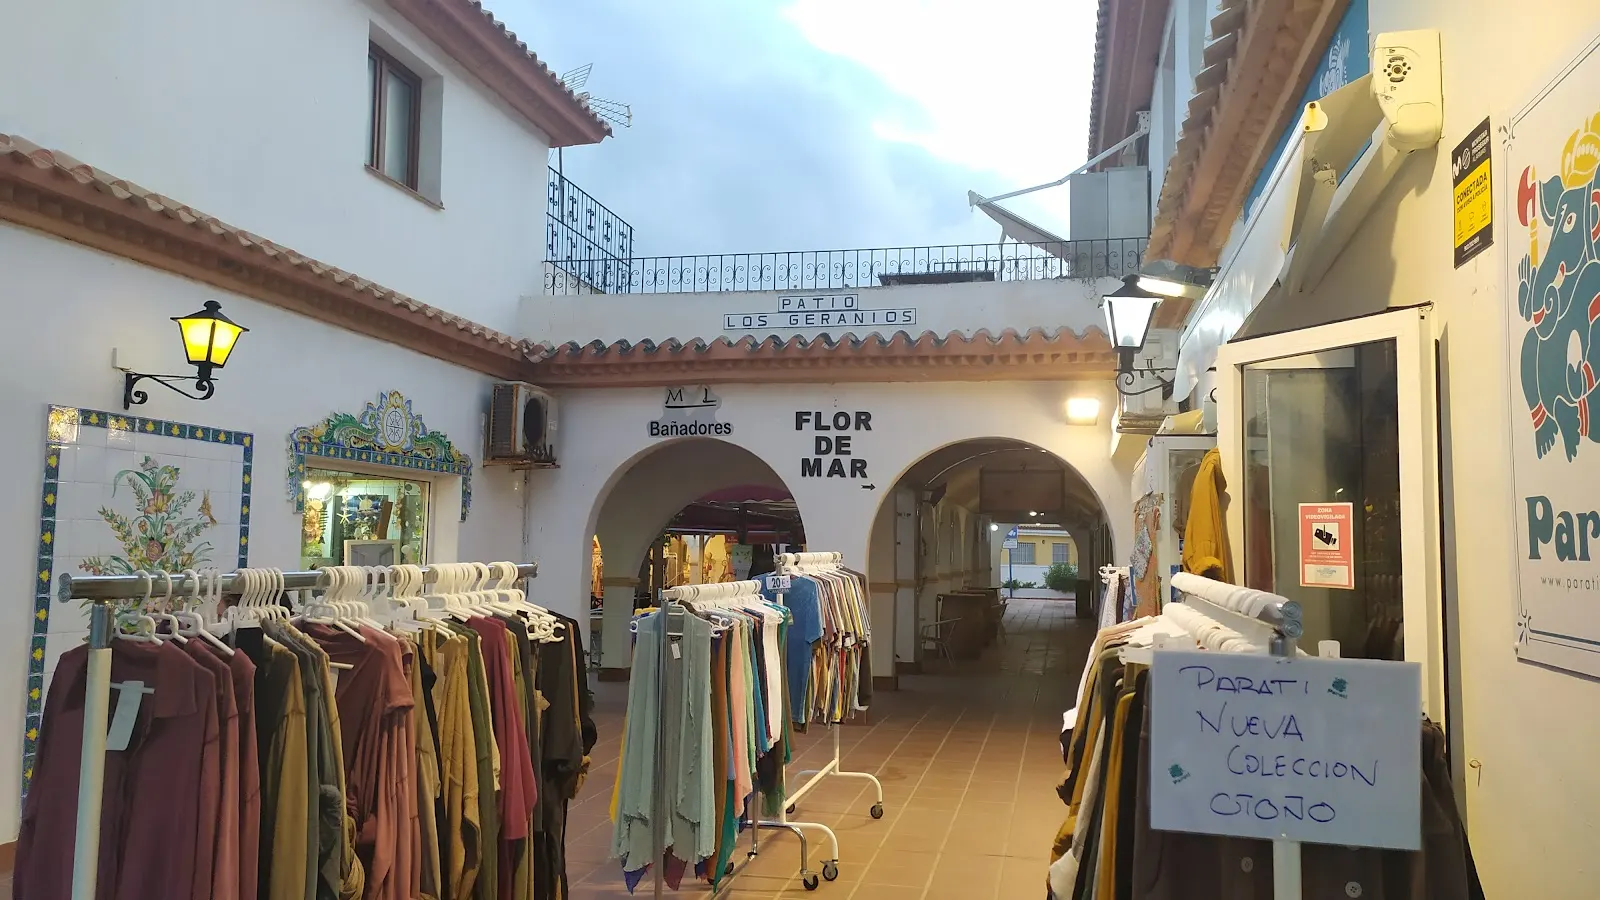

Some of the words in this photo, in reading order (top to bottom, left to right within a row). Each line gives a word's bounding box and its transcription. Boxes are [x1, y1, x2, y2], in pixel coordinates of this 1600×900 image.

[1456, 171, 1488, 205] CONECTADA
[782, 296, 855, 310] PATIO
[727, 315, 768, 328] LOS
[789, 311, 912, 326] GERANIOS
[650, 420, 732, 437] Bañadores
[795, 411, 873, 431] FLOR
[814, 435, 852, 456] DE
[801, 458, 868, 479] MAR
[1178, 665, 1309, 694] PARATI
[1196, 701, 1304, 742] NUEVA
[1226, 745, 1379, 787] COLECCION
[1209, 793, 1336, 823] OTOÑO
